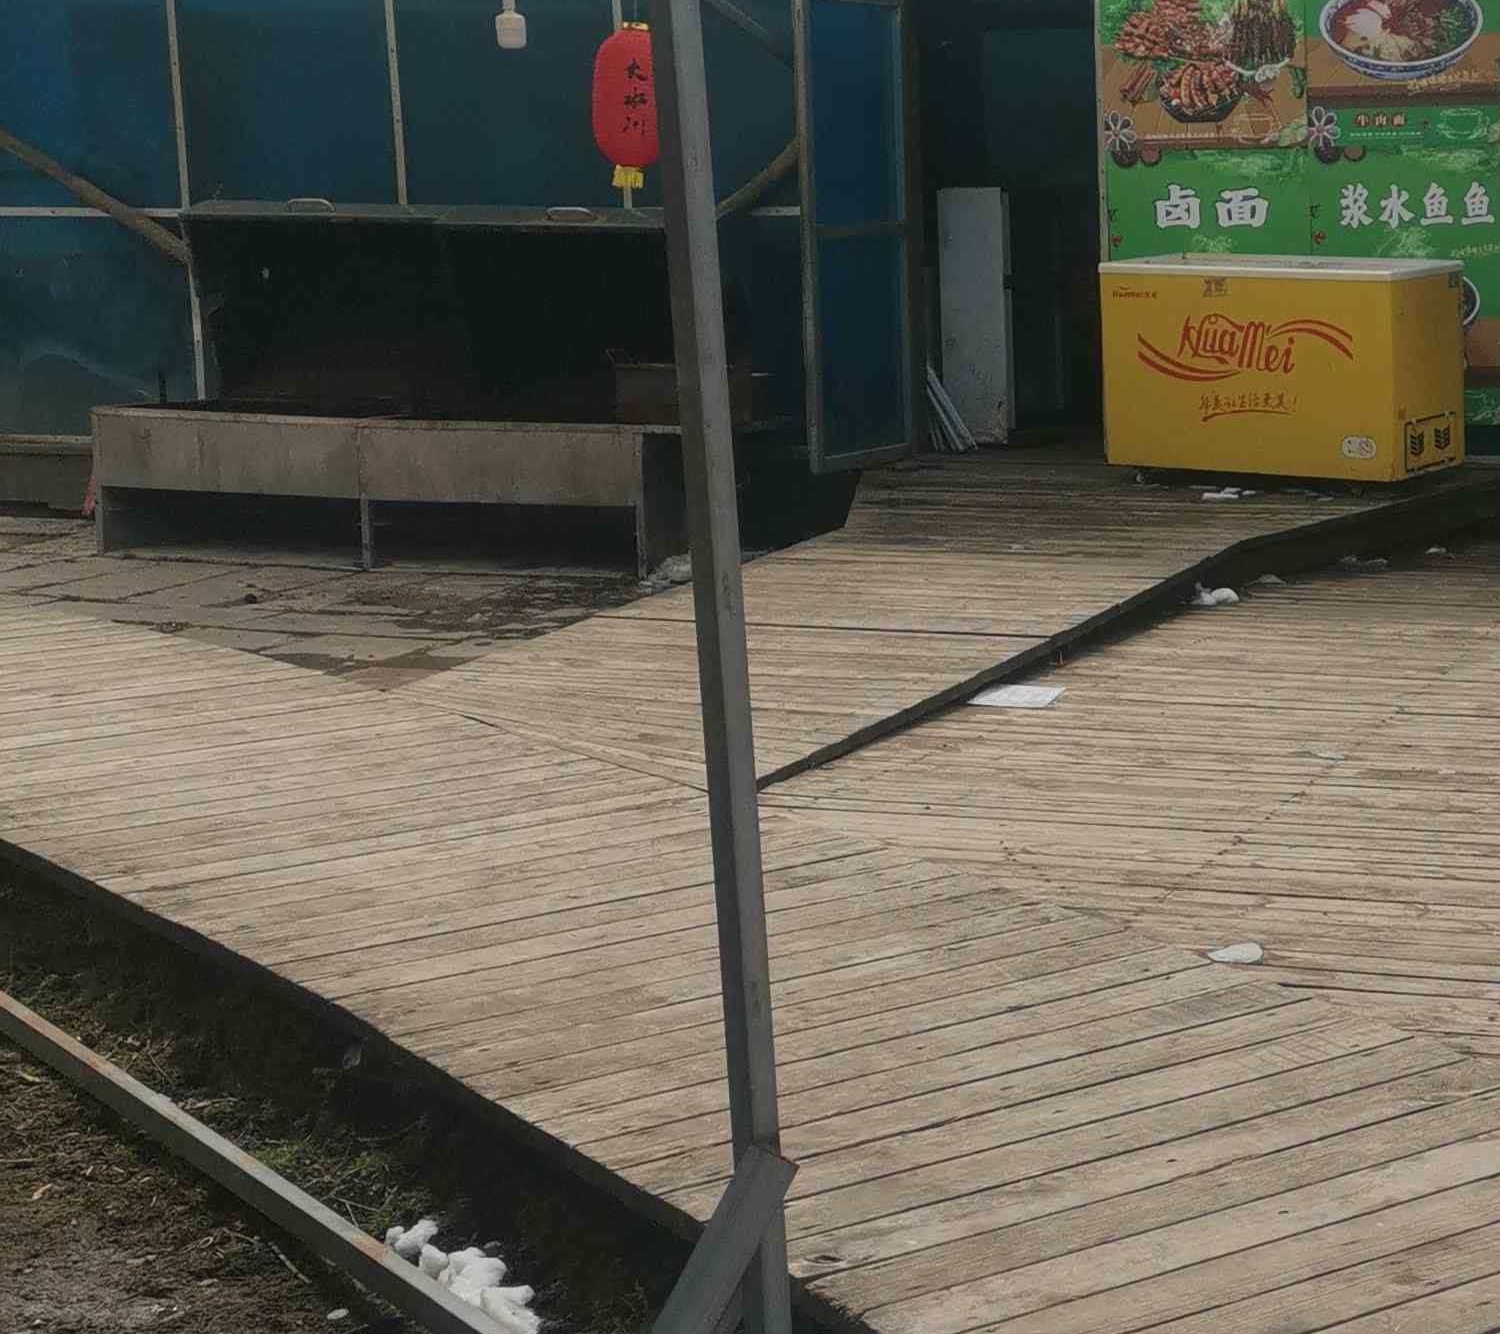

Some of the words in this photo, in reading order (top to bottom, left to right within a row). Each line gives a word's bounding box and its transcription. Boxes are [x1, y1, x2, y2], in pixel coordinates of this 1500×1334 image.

[1153, 183, 1270, 229] 卤面
[1340, 181, 1496, 229] 浆水鱼鱼
